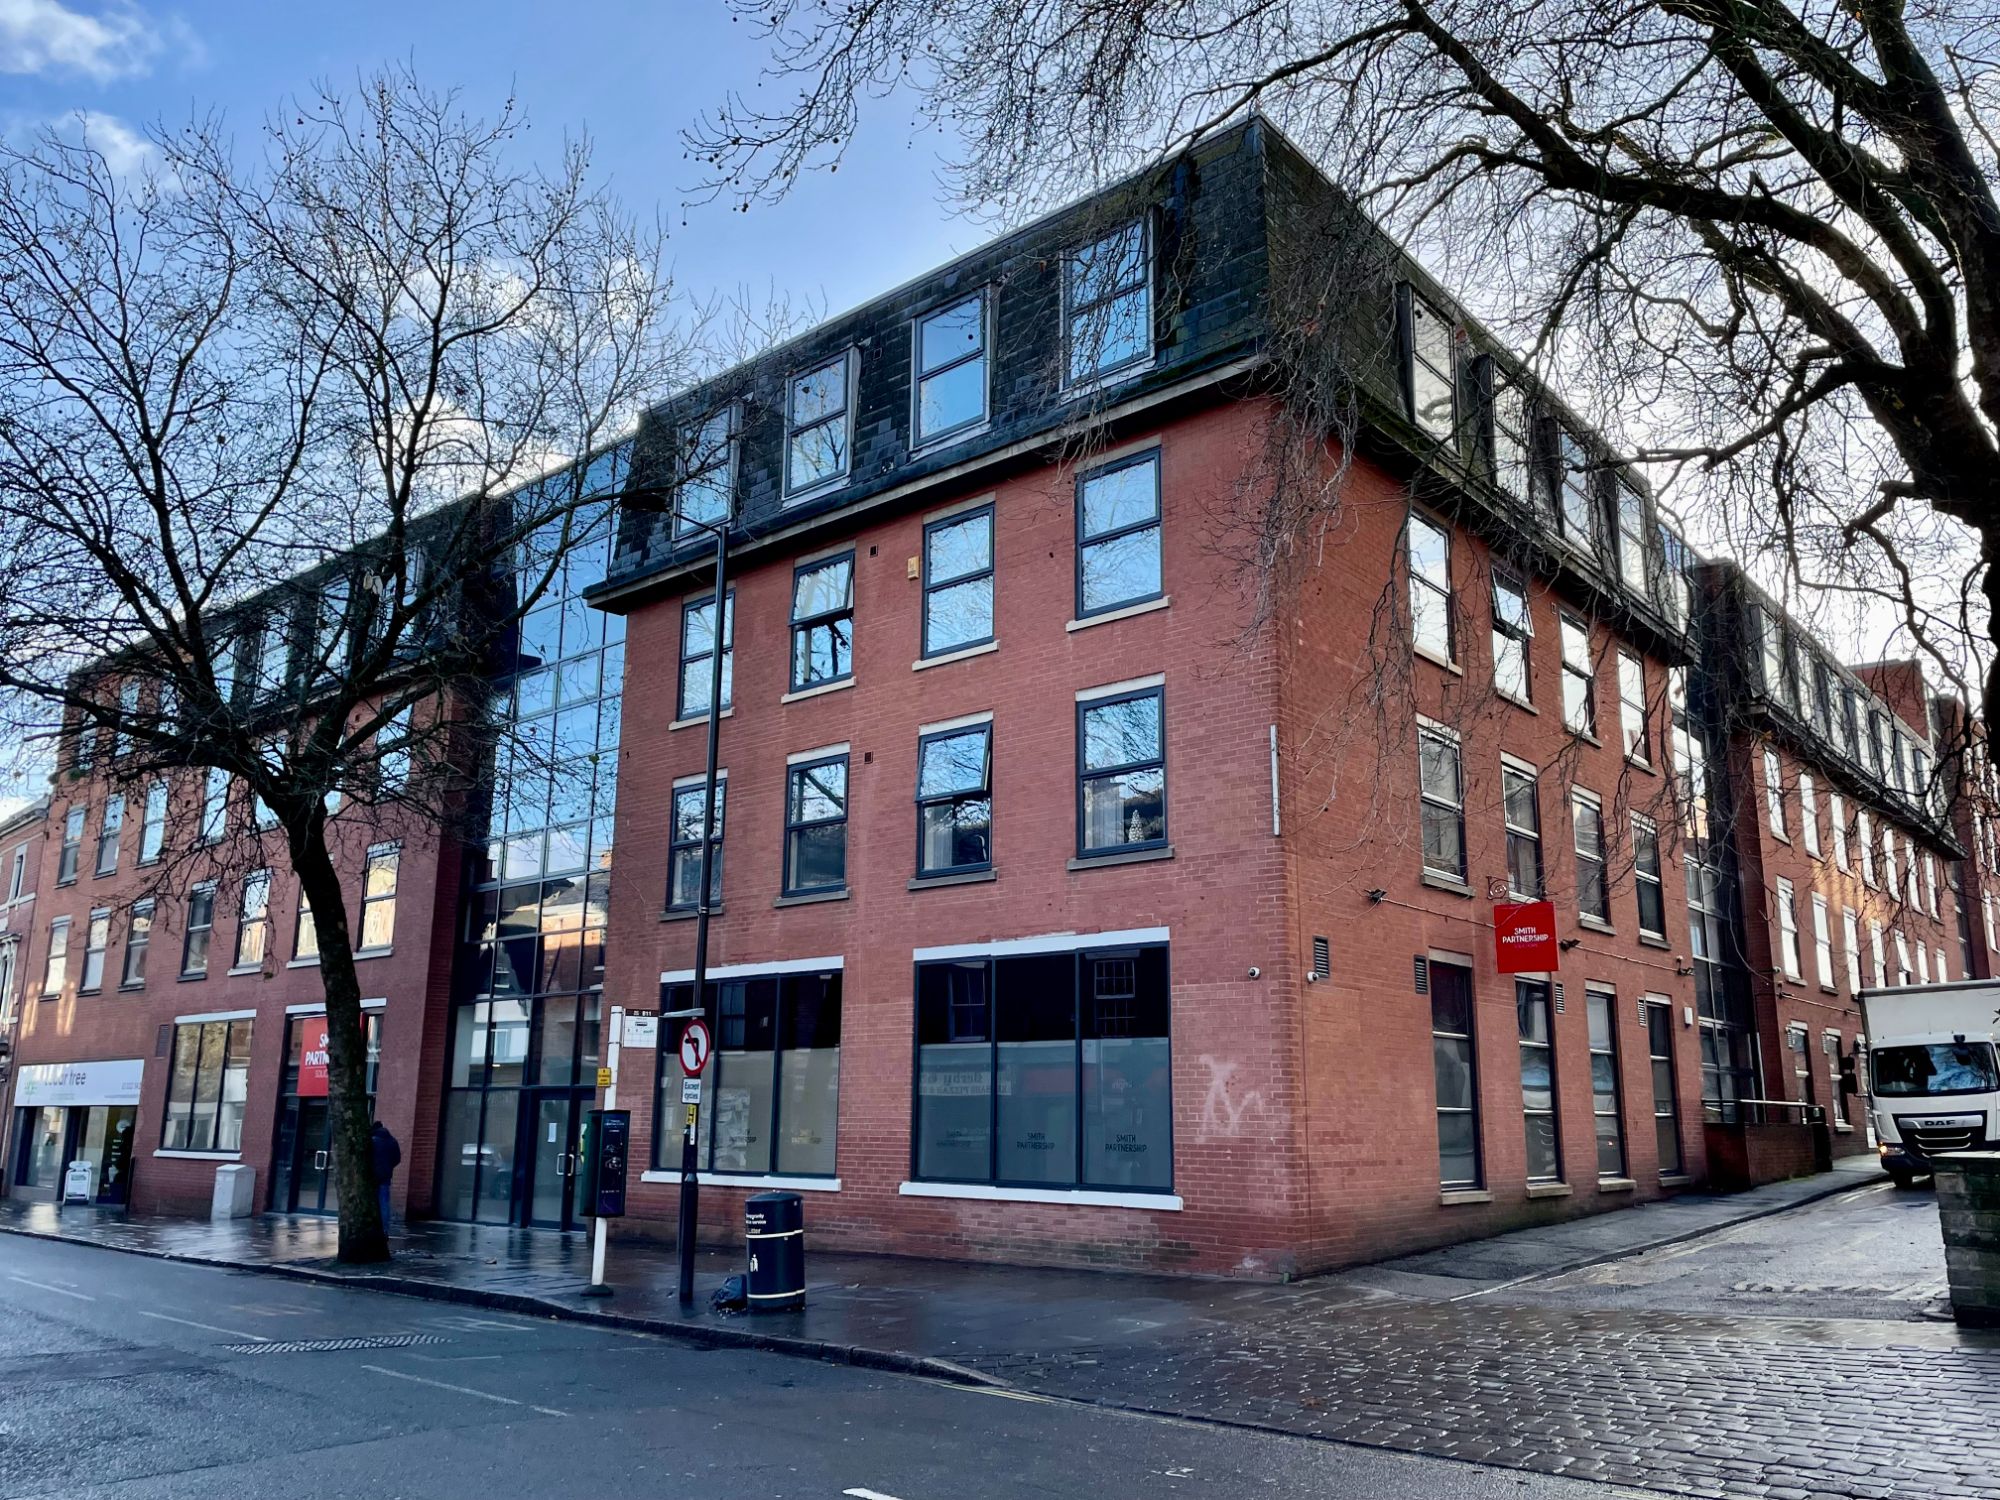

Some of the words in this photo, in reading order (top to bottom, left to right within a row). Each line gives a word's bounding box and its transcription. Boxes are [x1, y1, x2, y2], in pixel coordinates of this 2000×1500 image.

[1514, 927, 1536, 935] SMITH
[1502, 934, 1549, 944] PARTNERSHIP
[69, 1068, 86, 1086] tree
[684, 1081, 700, 1091] Except
[684, 1091, 699, 1100] cycles
[1027, 1132, 1045, 1141] SMITH
[1116, 1134, 1136, 1143] SMITH
[1016, 1141, 1055, 1151] PARTNERSHIP
[1105, 1143, 1147, 1154] PARTNERSHIP
